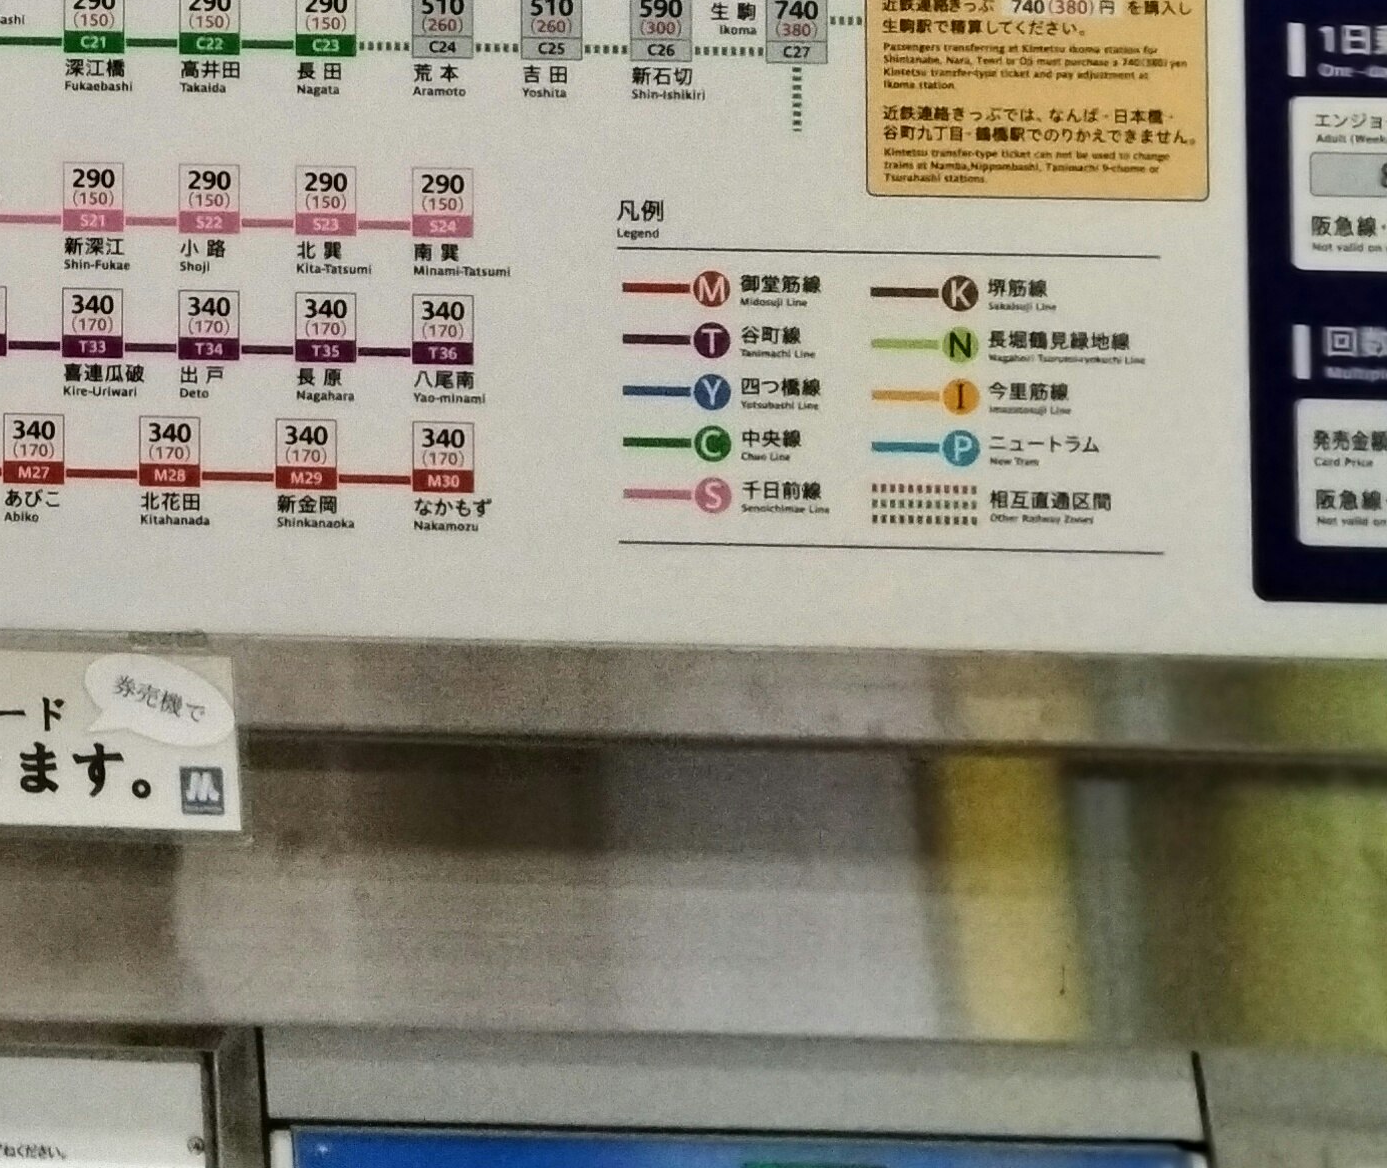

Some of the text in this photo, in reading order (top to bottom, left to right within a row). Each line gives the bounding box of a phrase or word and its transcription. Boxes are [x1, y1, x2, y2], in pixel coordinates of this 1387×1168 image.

[632, 67, 692, 85] 新石切
[618, 200, 663, 221] 凡例
[742, 275, 820, 294] 御堂筋線
[741, 325, 803, 346] 谷町線
[742, 378, 820, 396] 四つ橋線
[743, 430, 801, 447] 中央線
[990, 436, 1099, 452] ニュートラム
[743, 481, 821, 499] 千日前線
[415, 499, 492, 517] なかもず
[991, 491, 1112, 512] 相互直通区間
[110, 671, 208, 722] 券売機で
